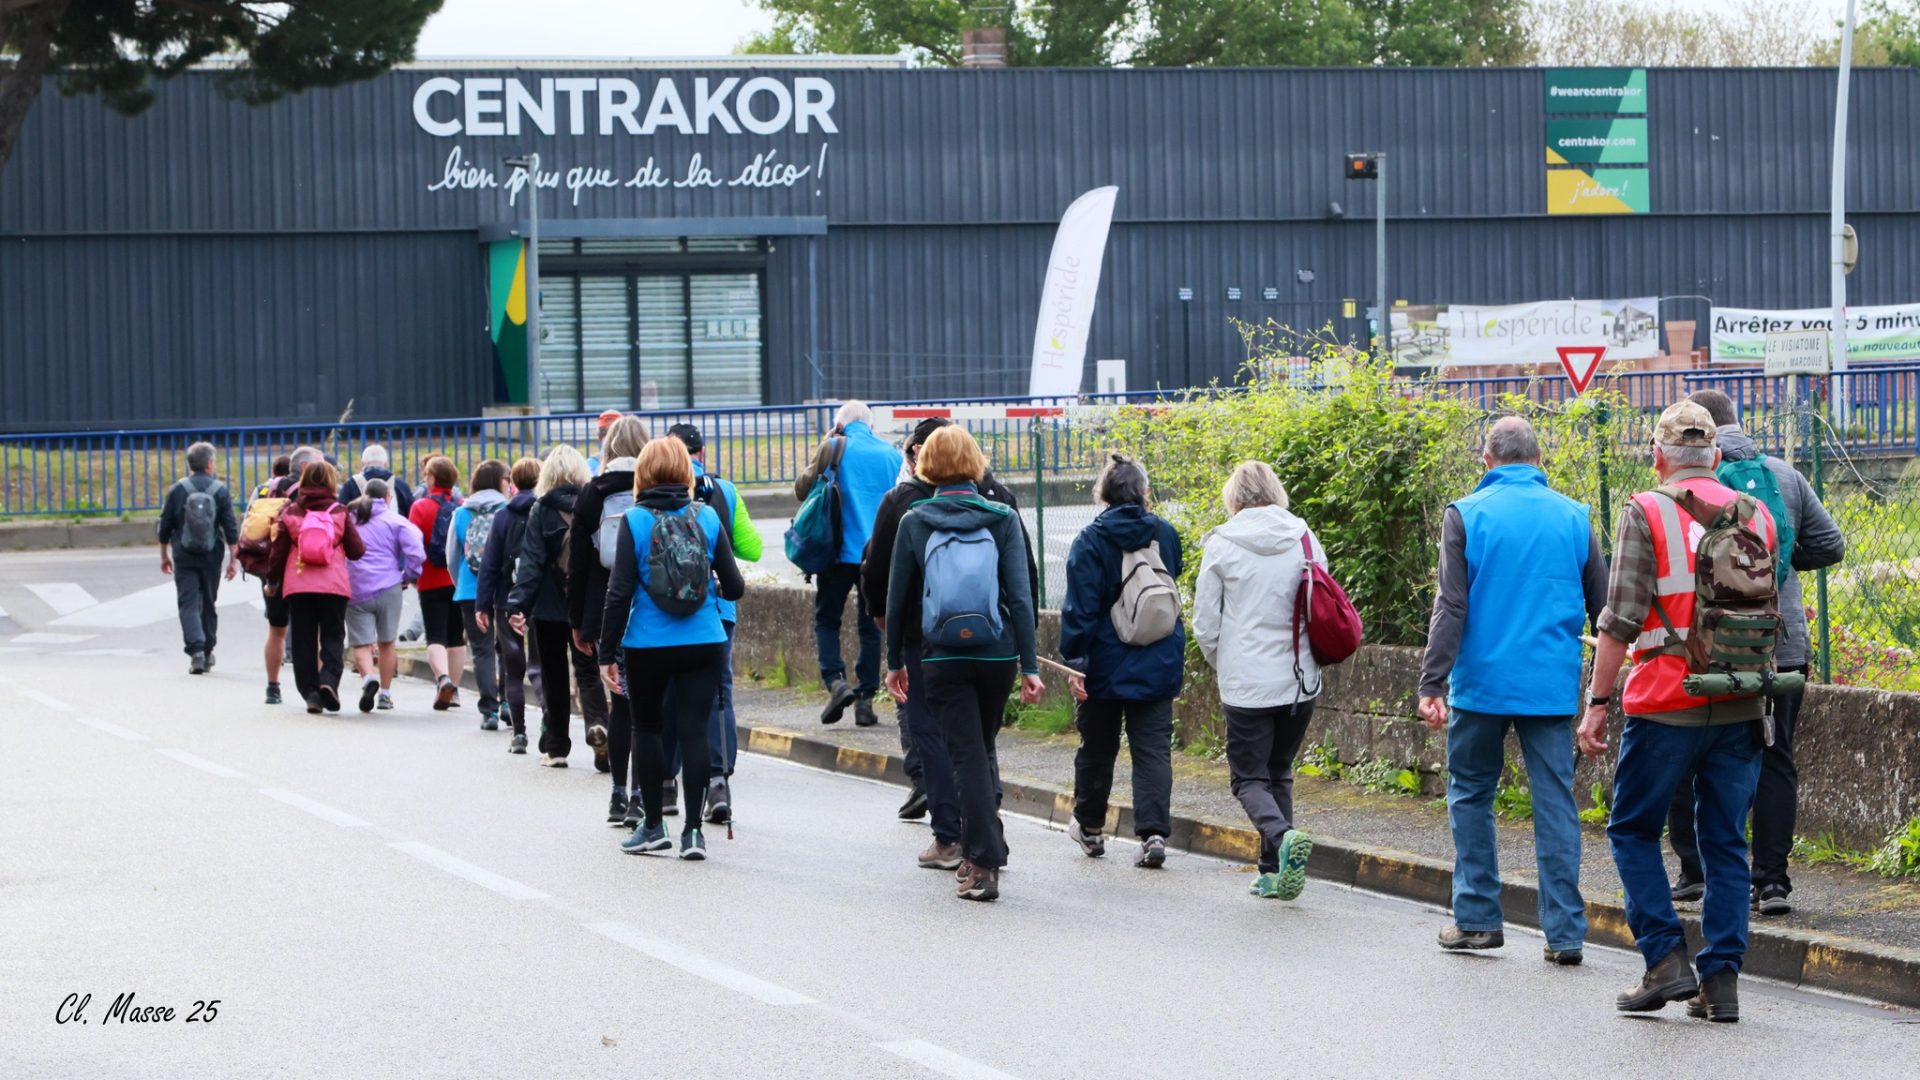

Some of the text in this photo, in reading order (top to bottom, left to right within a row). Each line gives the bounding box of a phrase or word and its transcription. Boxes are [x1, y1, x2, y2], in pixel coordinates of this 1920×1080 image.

[1550, 86, 1642, 97] #wearecentrakor
[413, 76, 839, 136] CENTRAKOR
[1558, 135, 1637, 148] centrakor.com
[428, 145, 498, 191] bien
[566, 166, 619, 206] que
[625, 156, 669, 187] de
[673, 152, 722, 187] la
[1714, 315, 1793, 334] Arrêtez
[1856, 314, 1868, 331] 5
